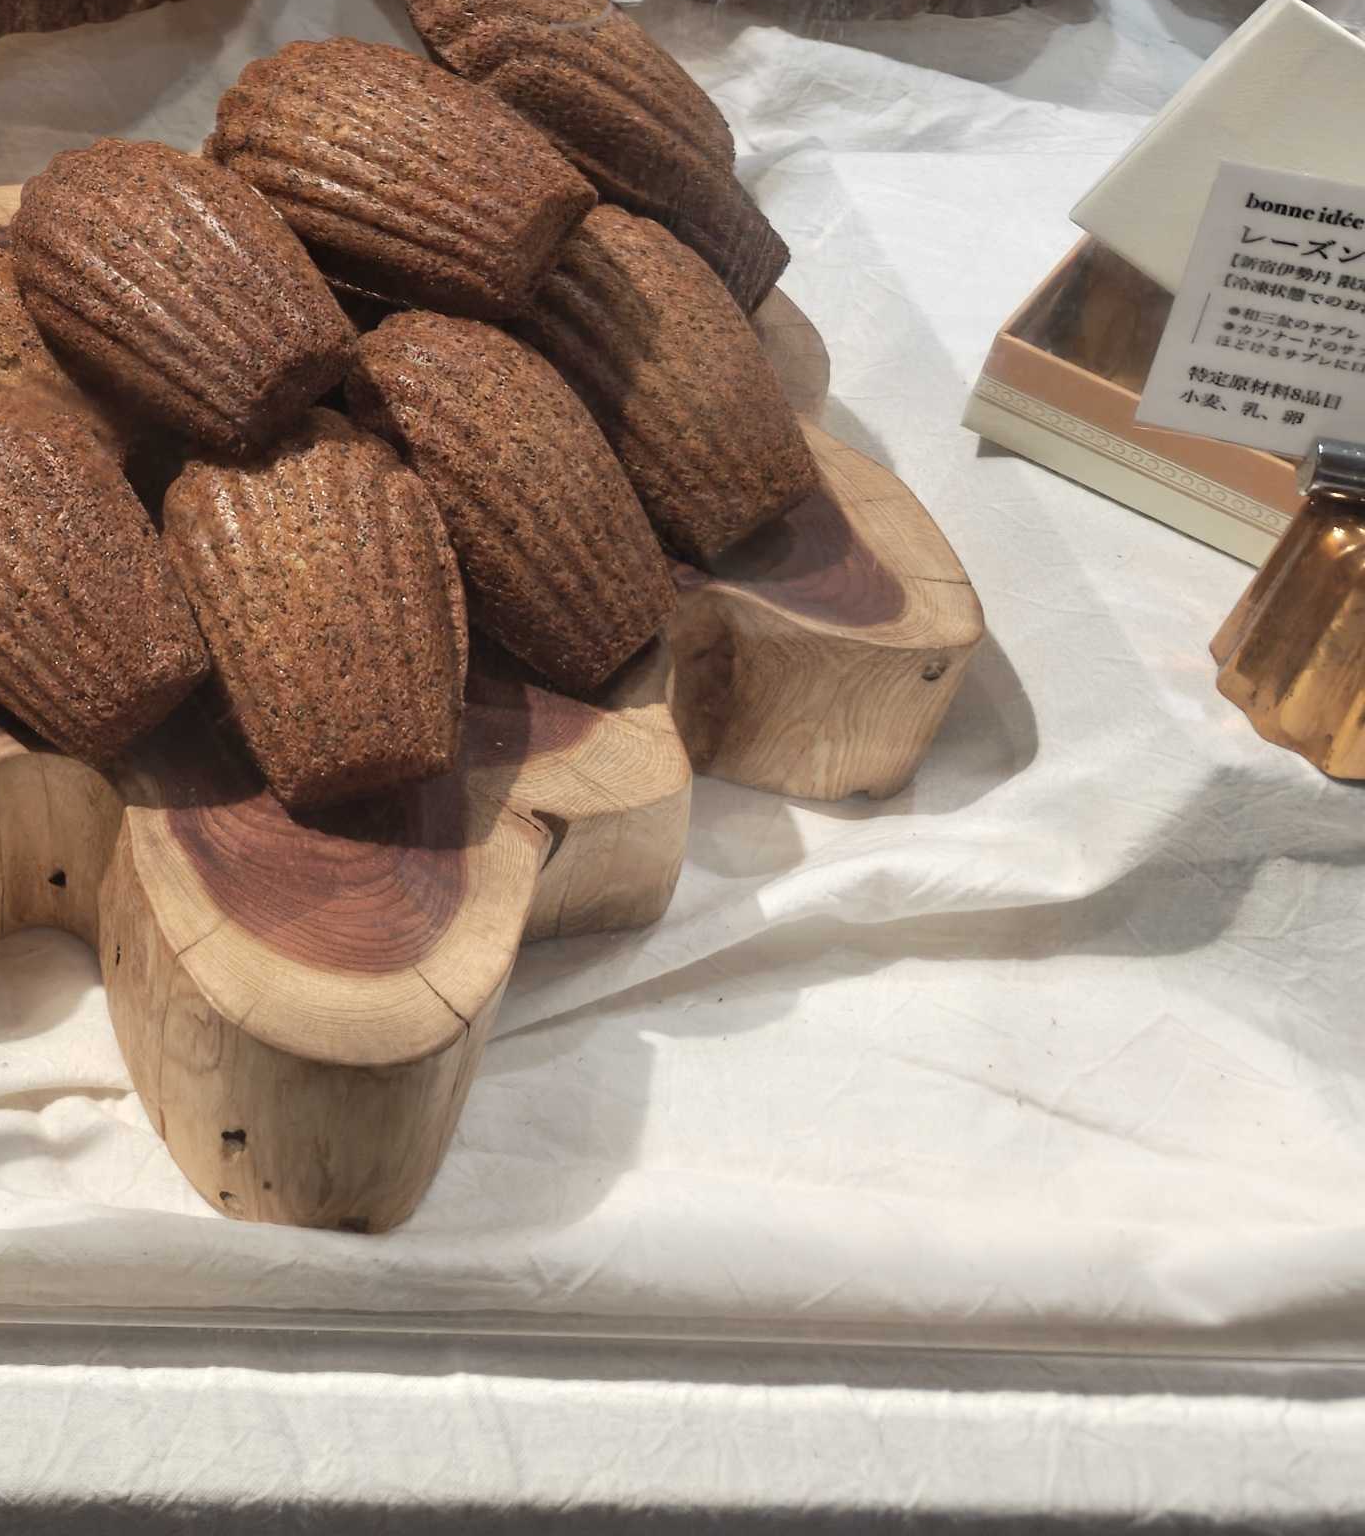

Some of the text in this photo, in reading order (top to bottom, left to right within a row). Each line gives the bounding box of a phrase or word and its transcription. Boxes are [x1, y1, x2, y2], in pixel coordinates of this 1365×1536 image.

[1245, 193, 1365, 229] bonne idée
[1189, 366, 1341, 410] 特定原材料8品目
